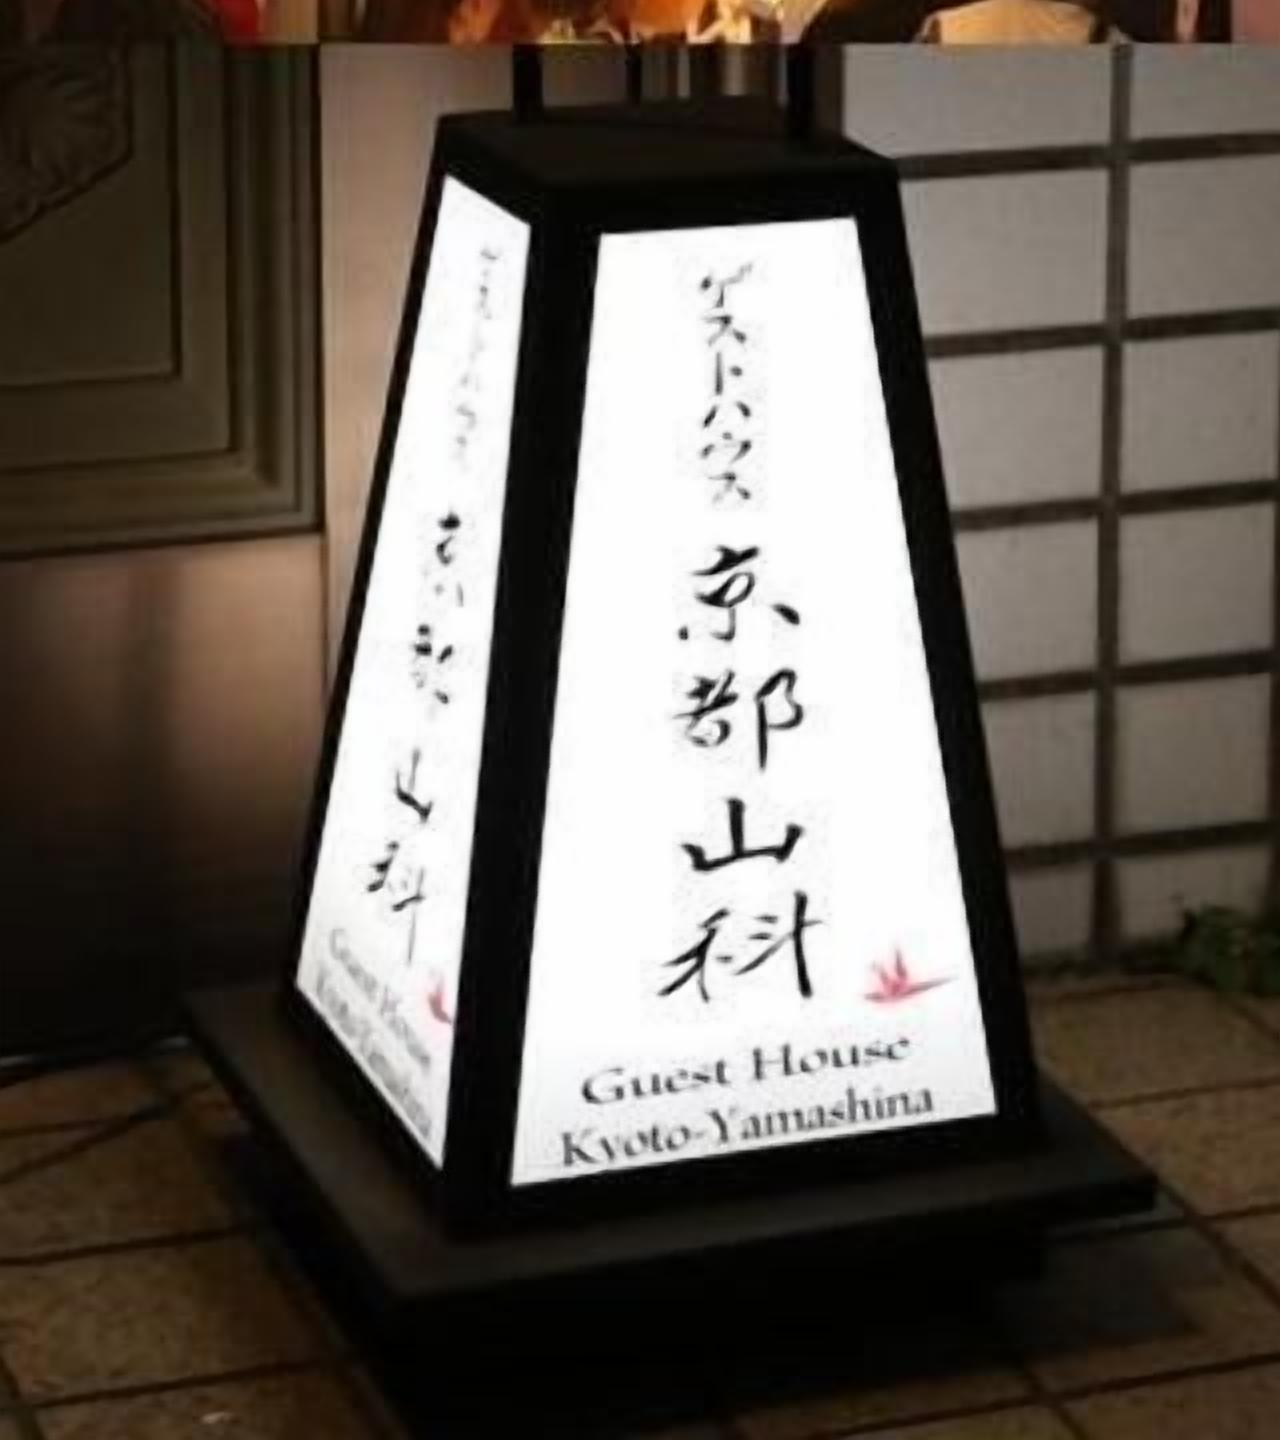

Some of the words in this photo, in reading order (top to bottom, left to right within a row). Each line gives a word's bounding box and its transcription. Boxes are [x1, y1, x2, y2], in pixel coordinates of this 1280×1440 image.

[699, 262, 754, 504] ゲストハウス
[657, 544, 824, 1003] 京都山科
[560, 1085, 934, 1168] Kyoto-Yamashina
[581, 1058, 732, 1106] Guest
[752, 1037, 911, 1081] House
